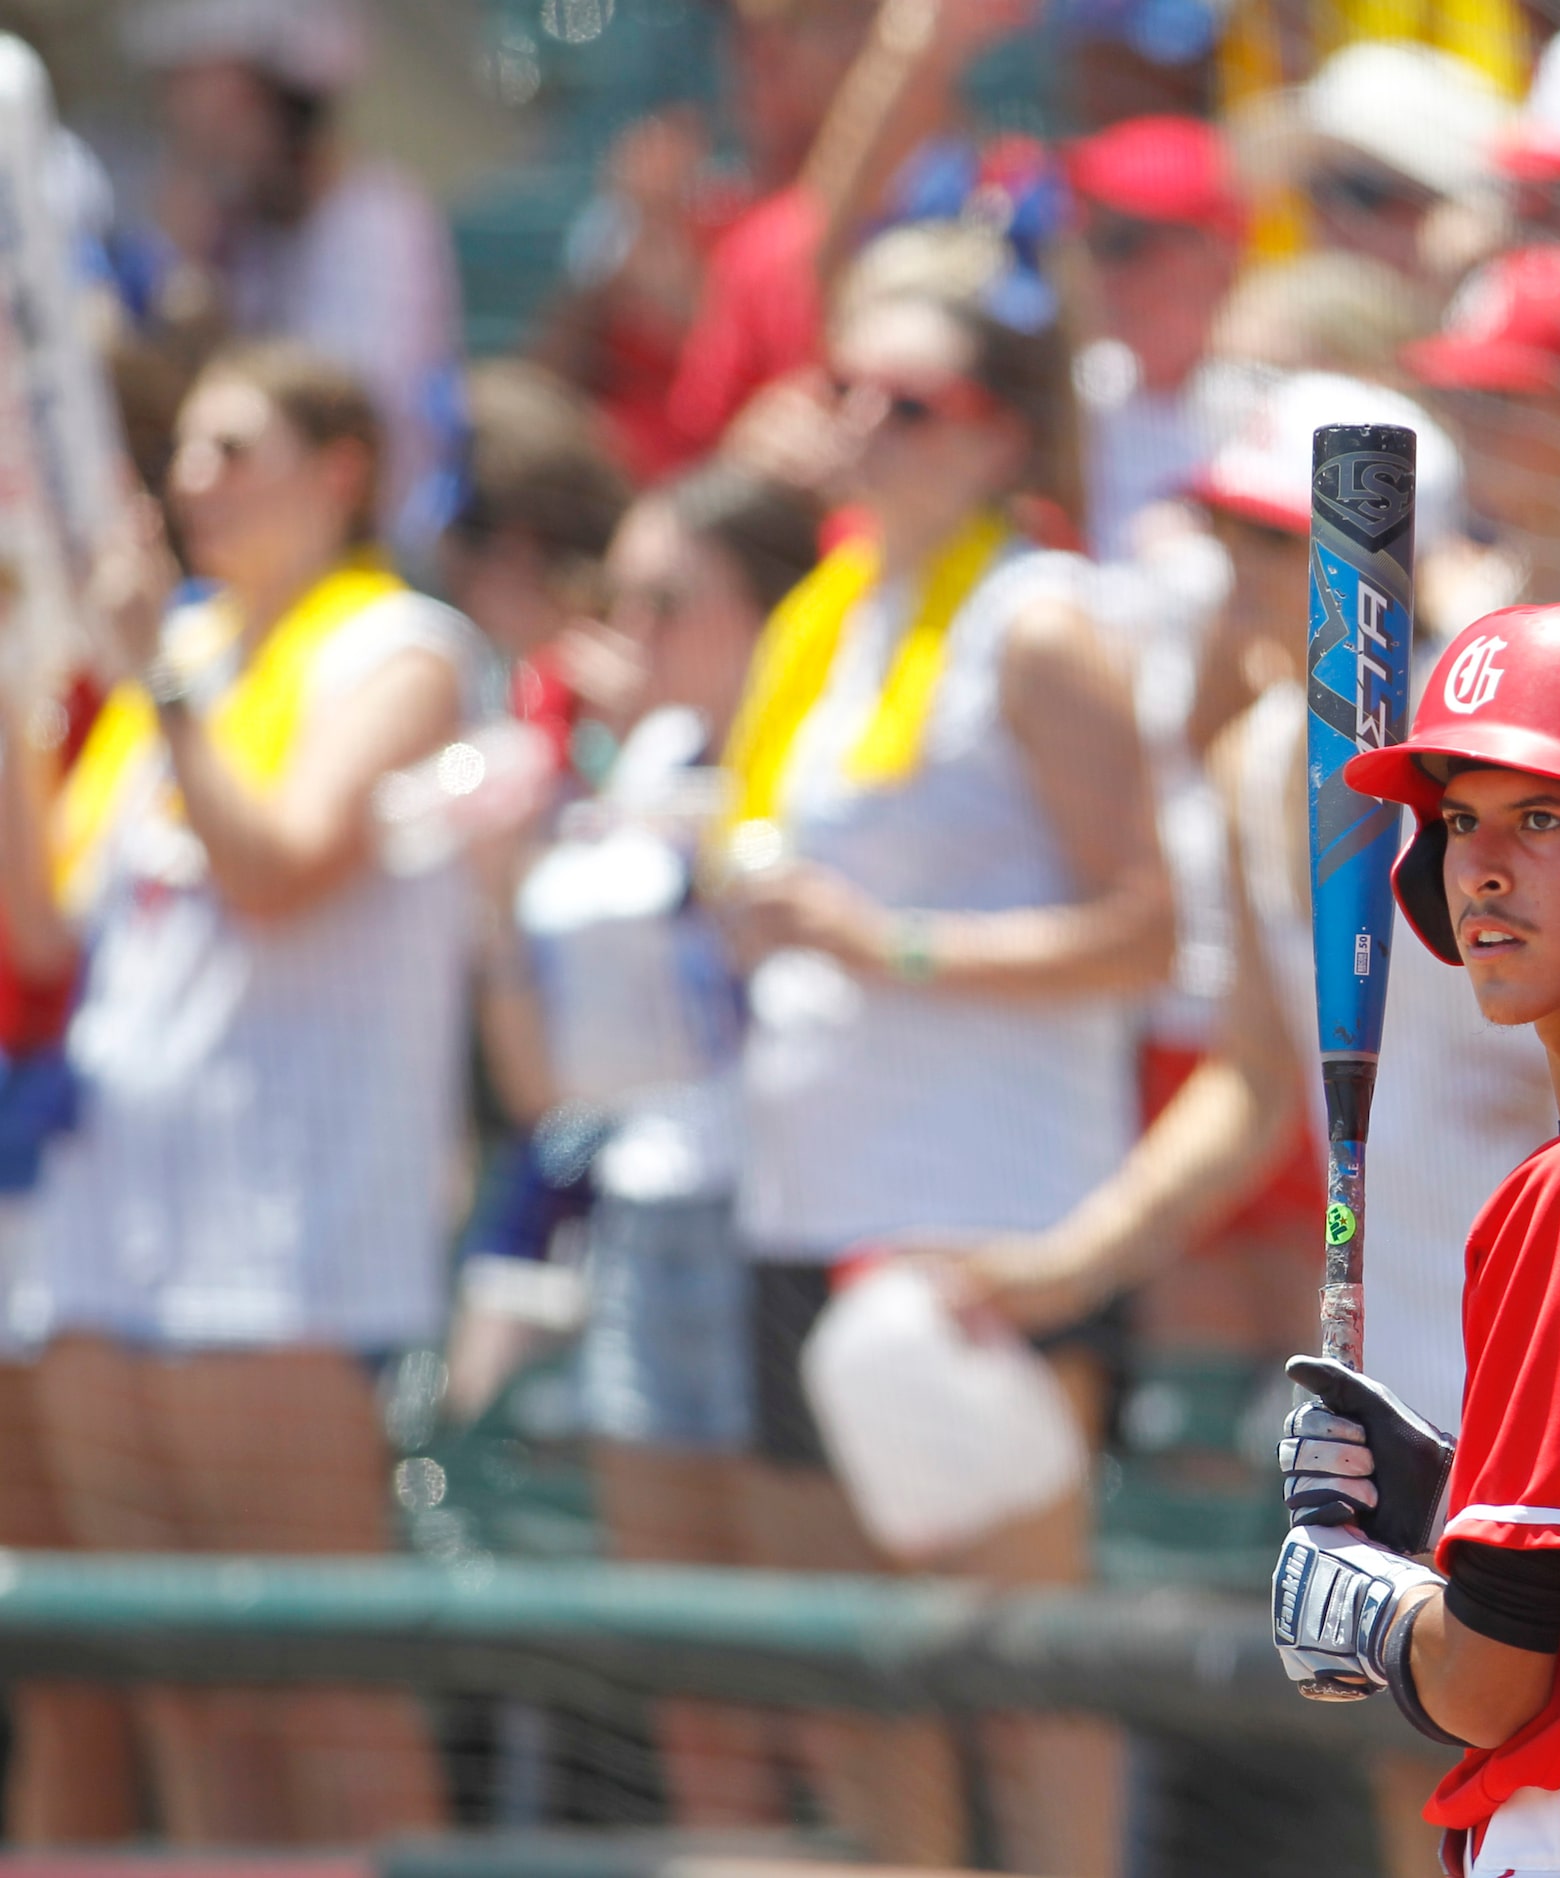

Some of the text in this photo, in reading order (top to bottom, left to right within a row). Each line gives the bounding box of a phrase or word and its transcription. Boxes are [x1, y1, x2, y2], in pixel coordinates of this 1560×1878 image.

[1356, 579, 1388, 758] ETA
[1443, 634, 1508, 714] G
[1276, 1545, 1309, 1644] Franklin
